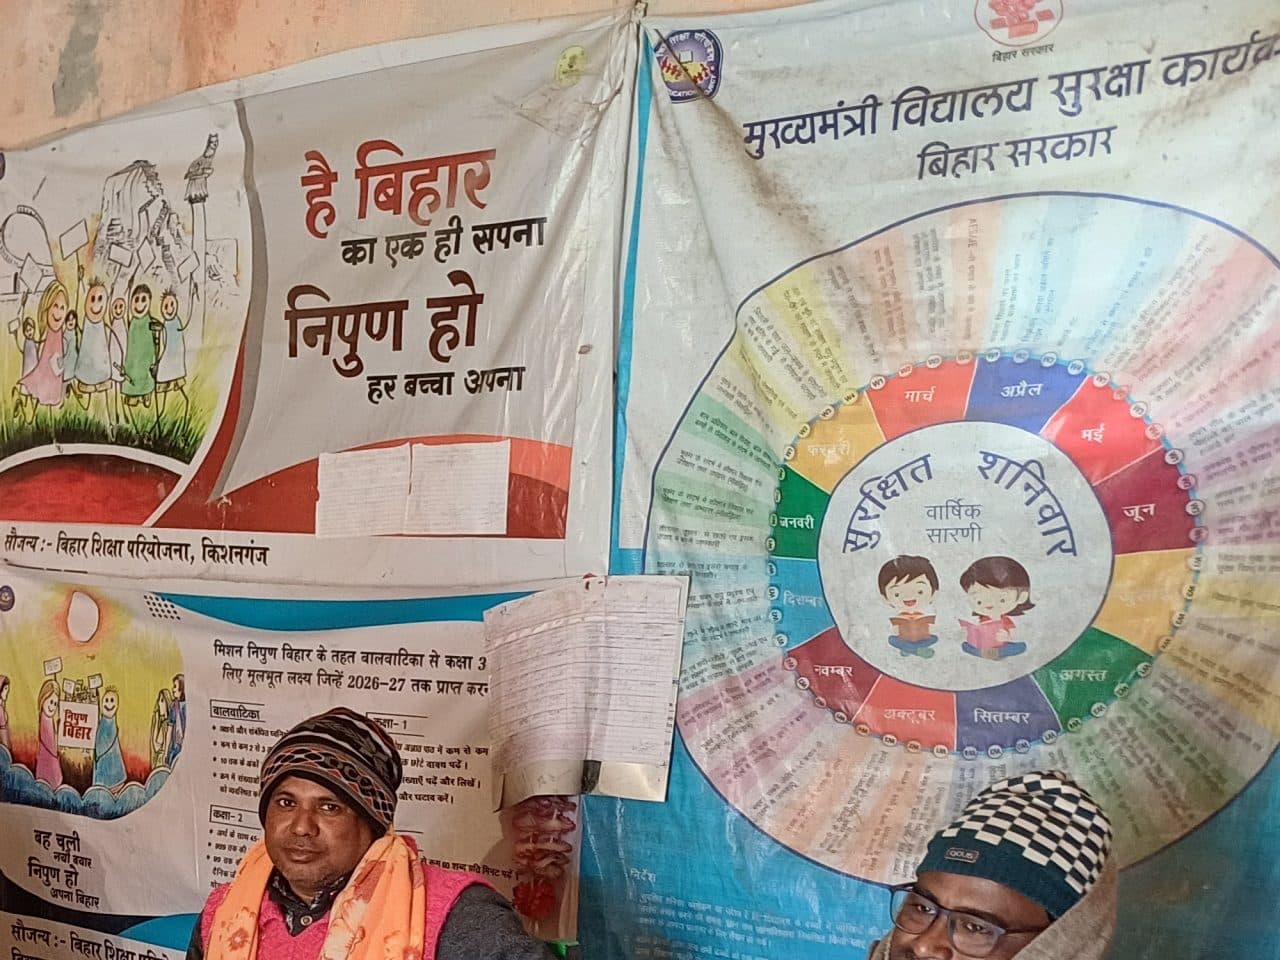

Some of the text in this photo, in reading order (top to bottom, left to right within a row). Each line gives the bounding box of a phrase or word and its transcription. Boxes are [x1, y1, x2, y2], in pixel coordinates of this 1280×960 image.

[992, 49, 1018, 63] बिहार
[743, 93, 880, 159] मुख्यमंत्री
[892, 77, 1038, 132] विद्यालय
[1049, 58, 1152, 115] सुरक्षा
[917, 125, 1118, 181] बिहार सरकार
[301, 139, 496, 239] है बिहार
[341, 215, 548, 268] का एक ही सपना
[284, 269, 484, 378] निपुण हो
[366, 366, 526, 404] हर बच्चा अपना
[1000, 380, 1044, 398] अप्रैल
[1081, 422, 1107, 444] मई
[842, 453, 933, 553] सुरक्षित
[977, 450, 1078, 557] शनिवार
[924, 498, 984, 520] वार्षिक
[1121, 503, 1156, 522] जून
[779, 514, 815, 530] जनवरी
[925, 521, 984, 544] सारणी
[4, 527, 40, 553] सौजन्य
[56, 532, 88, 559] बिहार
[91, 532, 125, 558] शिक्षा
[202, 537, 270, 566] किशनगंज
[213, 639, 243, 658] मिशन
[247, 641, 278, 664] निपुण
[316, 645, 327, 662] के
[331, 649, 357, 665] तहत
[429, 650, 440, 668] से
[445, 655, 473, 670] कक्षा
[478, 656, 487, 671] 3
[222, 663, 243, 683] लिए
[247, 669, 283, 688] मूलभूत
[286, 672, 313, 685] लक्ष्य
[316, 668, 344, 688] जिन्हें
[410, 678, 432, 693] तक
[436, 680, 464, 695] प्राप्त
[973, 708, 1032, 724] सितम्बर
[55, 831, 81, 852] चली
[28, 856, 79, 888] निपुण हो
[50, 887, 74, 902] अपना
[10, 919, 52, 947] सौजन्य
